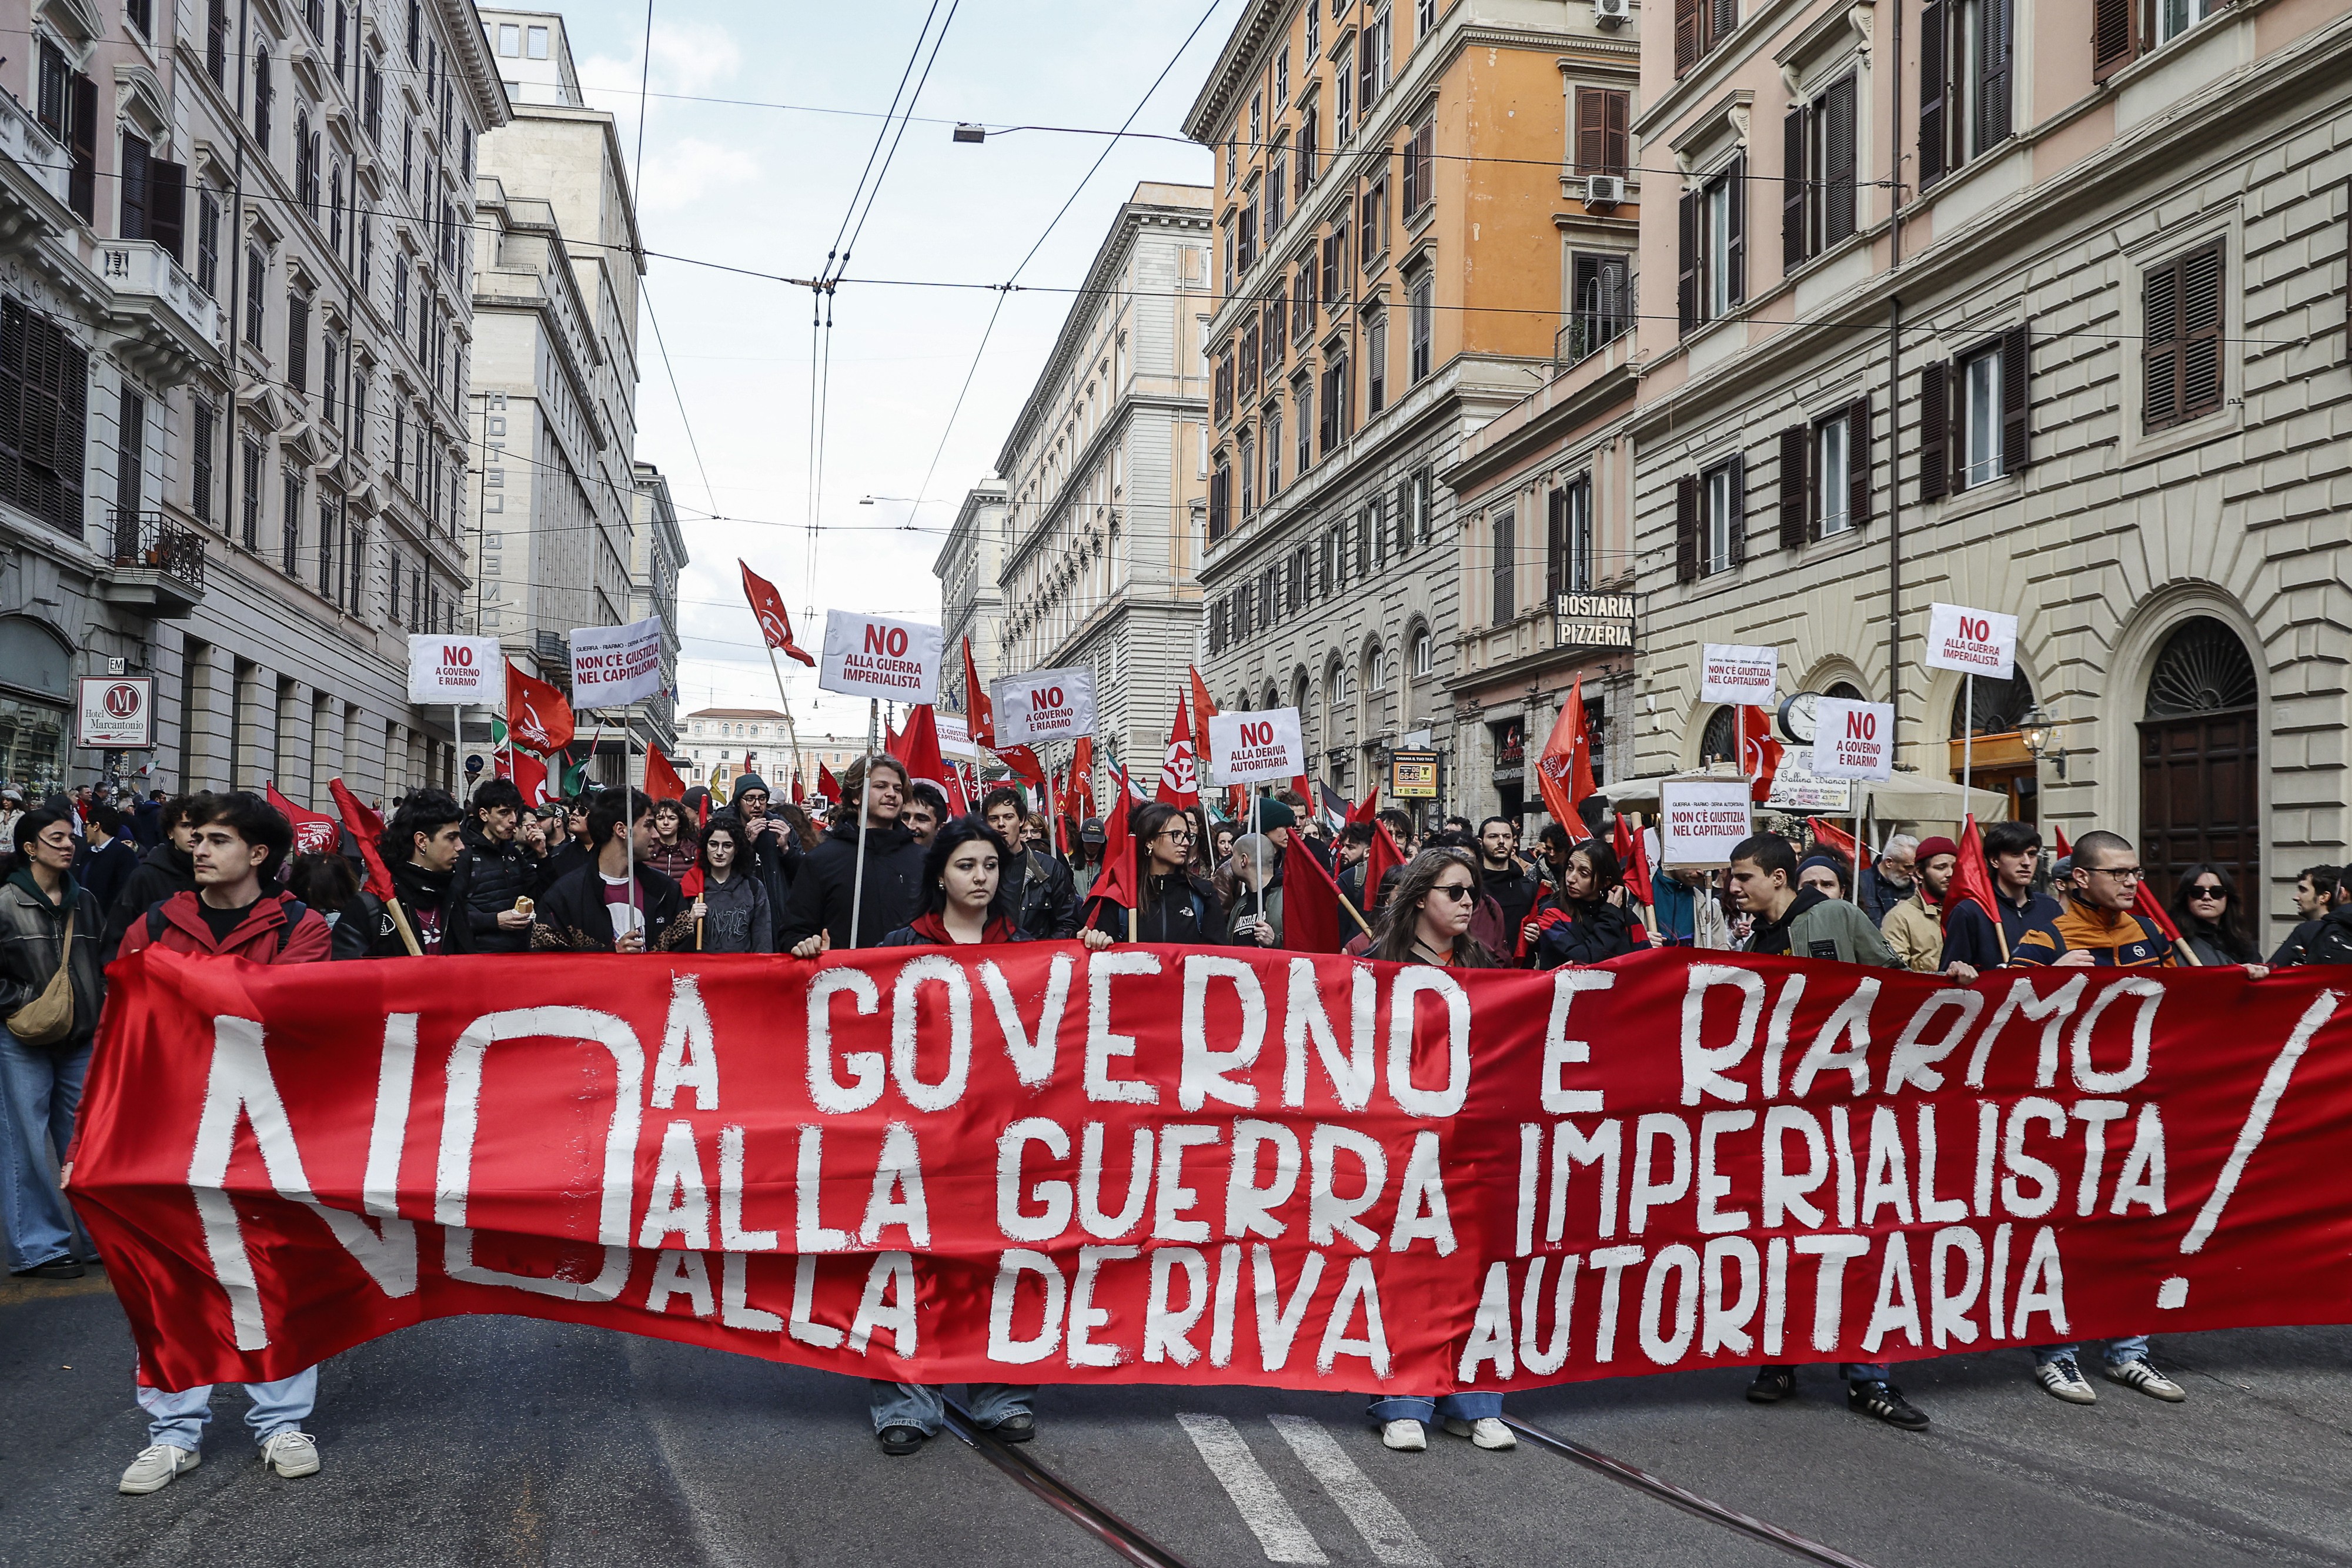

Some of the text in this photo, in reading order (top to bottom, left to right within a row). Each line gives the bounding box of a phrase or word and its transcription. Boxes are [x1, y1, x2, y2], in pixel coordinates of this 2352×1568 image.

[1558, 595, 1634, 617] HOSTARIA
[1561, 624, 1632, 646] PIZZERIA
[1959, 616, 1990, 642] NO
[864, 624, 908, 657] NO
[1945, 638, 2000, 656] ALLA GUERRA
[110, 659, 123, 670] EM
[443, 646, 472, 666] NO
[576, 642, 659, 670] NON C'È GIUSTIZIA
[844, 654, 922, 674] ALLA GUERRA
[1943, 648, 1999, 667] IMPERIALISTA
[435, 667, 480, 677] A GOVERNO
[577, 656, 658, 684] NEL CAPITALISMO
[843, 668, 921, 689] IMPERIALISTA
[1708, 665, 1770, 677] NON C'È GIUSTIZIA
[445, 677, 477, 686] RIARMO
[1708, 675, 1769, 686] NEL CAPITALISMO
[112, 690, 133, 713] M
[1031, 686, 1064, 711] NO
[1806, 696, 1815, 704] 12
[85, 709, 104, 717] Hotel
[1025, 707, 1073, 723] A GOVERNO
[91, 718, 143, 730] Marcantonio
[1030, 718, 1071, 732] E RIARMO
[1846, 711, 1876, 740] NO
[1240, 721, 1274, 748] NO
[1231, 745, 1286, 761] ALLA DERIVA
[1836, 740, 1880, 754] A GOVERNO
[1231, 756, 1288, 773] AUTORITARIA
[1839, 754, 1877, 767] E RIARMO
[1781, 770, 1812, 783] Gallina
[1672, 810, 1745, 823] NON C'È GIUSTIZIA
[1673, 825, 1745, 836] NEL CAPITALISMO
[651, 952, 2166, 1117] A GOVERNO E RIARMO
[186, 1005, 645, 1350] NO
[639, 1096, 2167, 1257] ALLA GUERRA IMPERIALISTA
[646, 1223, 2070, 1383] ALLA DERIVA AUTORITARIA
